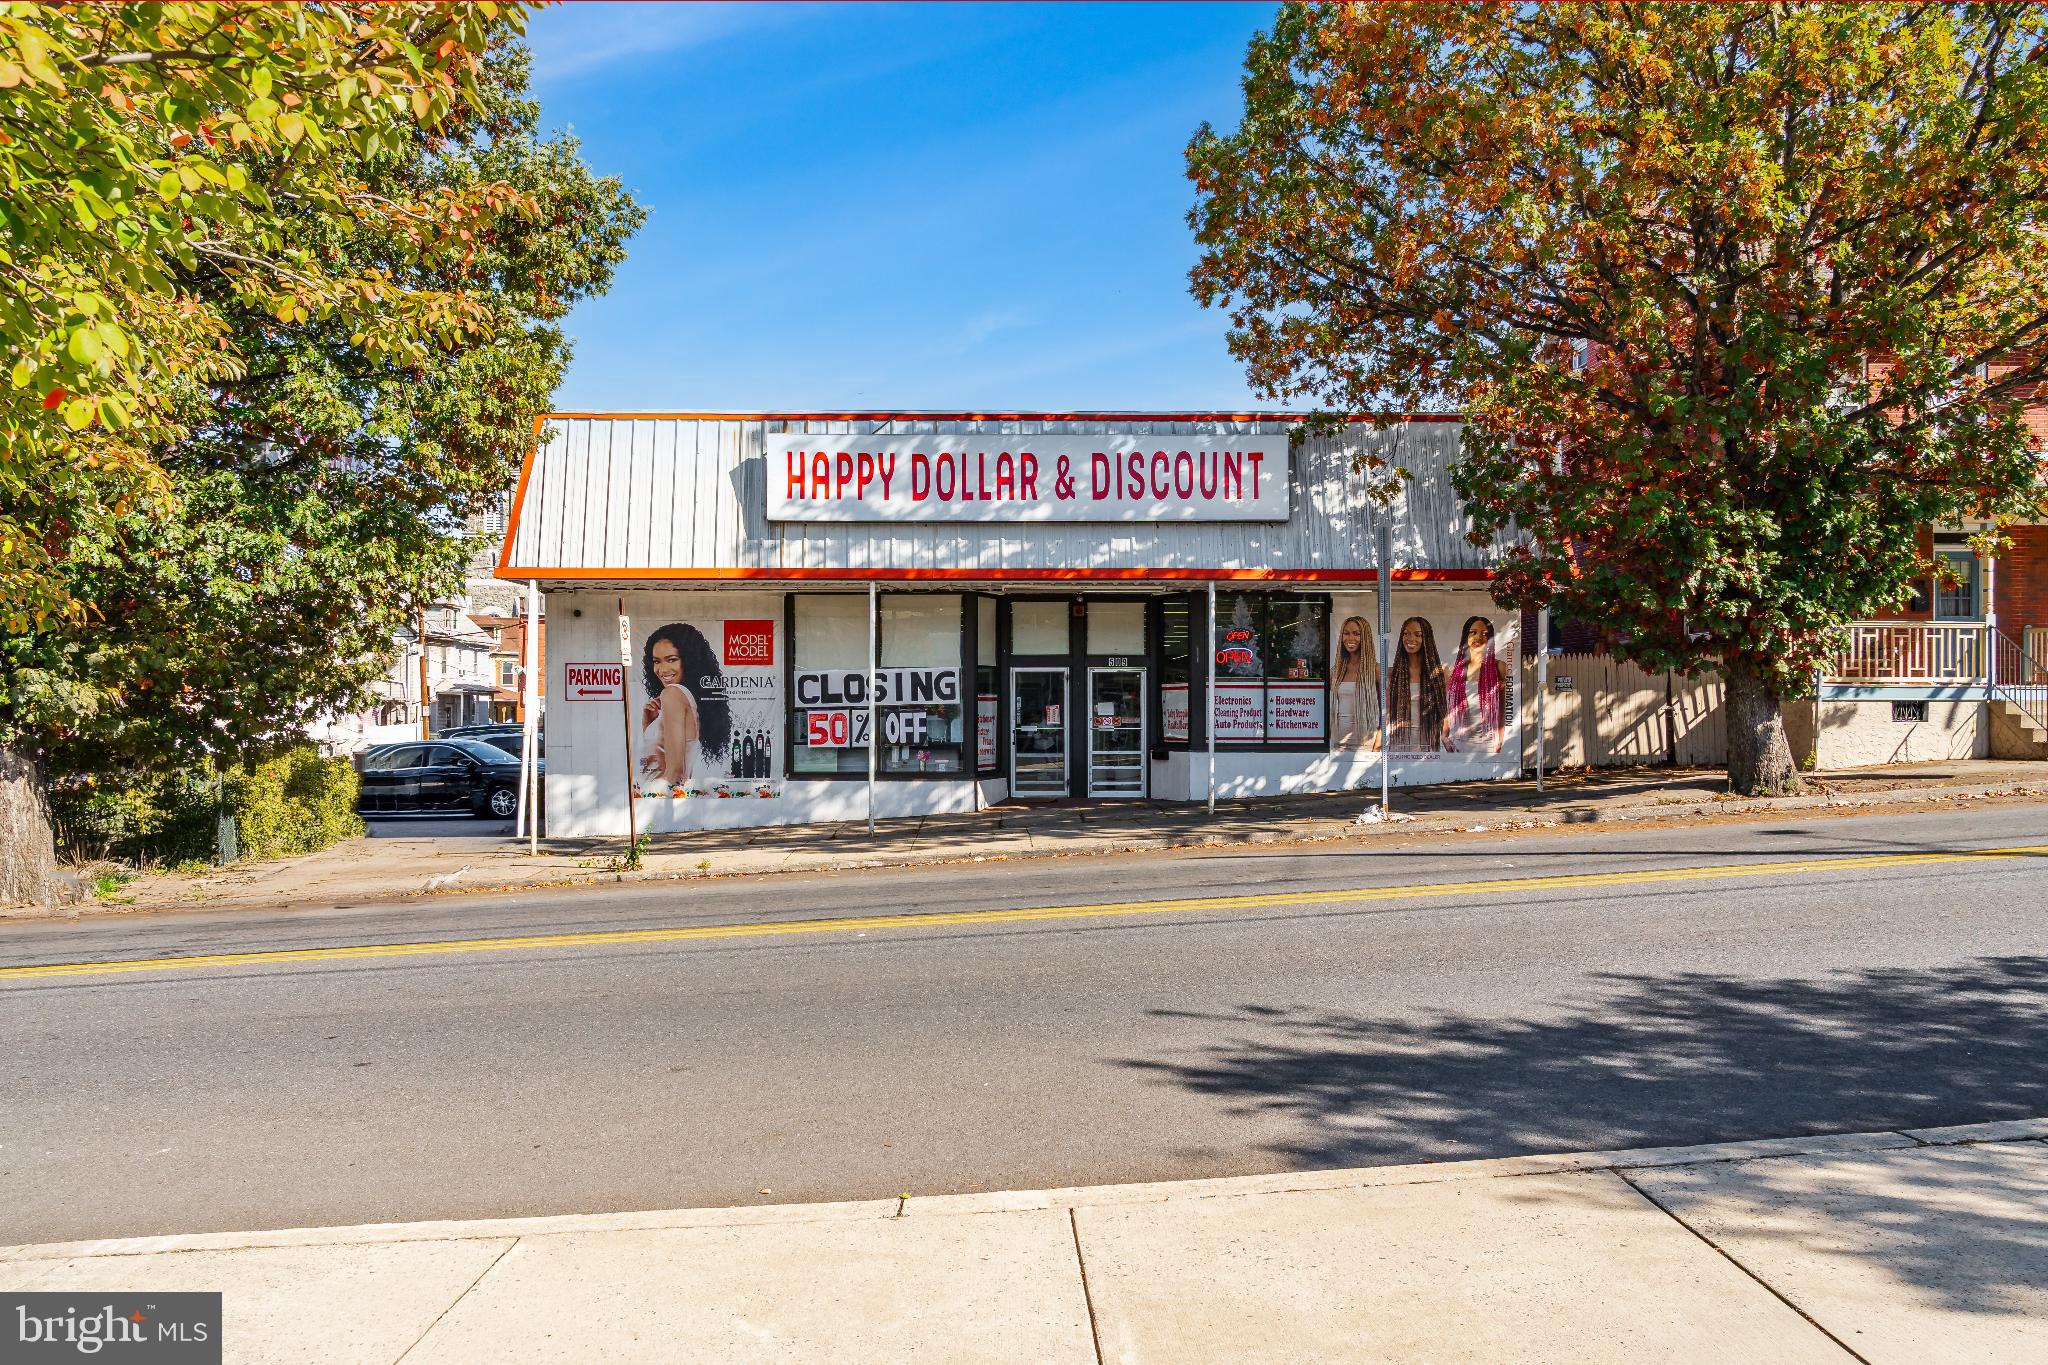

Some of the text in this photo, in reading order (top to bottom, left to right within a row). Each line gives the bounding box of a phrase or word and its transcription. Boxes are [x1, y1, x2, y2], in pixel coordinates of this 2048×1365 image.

[786, 451, 1265, 501] HAPPY DOLLAR & DISCOUNT
[728, 634, 769, 645] MODEL
[1226, 630, 1250, 641] OPEN
[728, 646, 769, 656] MODEL
[1215, 650, 1252, 665] OPEN
[568, 668, 621, 686] PARKING
[699, 675, 774, 689] GARDENIA
[797, 671, 956, 704] CLOSING
[1213, 696, 1252, 705] Electronics
[1275, 696, 1316, 705] Housewares
[1504, 675, 1514, 727] FORMATION
[1213, 707, 1239, 719] Cleaning
[1275, 707, 1310, 717] Hardware
[885, 711, 927, 744] OFF
[1213, 720, 1231, 729] Auto
[1275, 720, 1319, 729] Kitchenware
